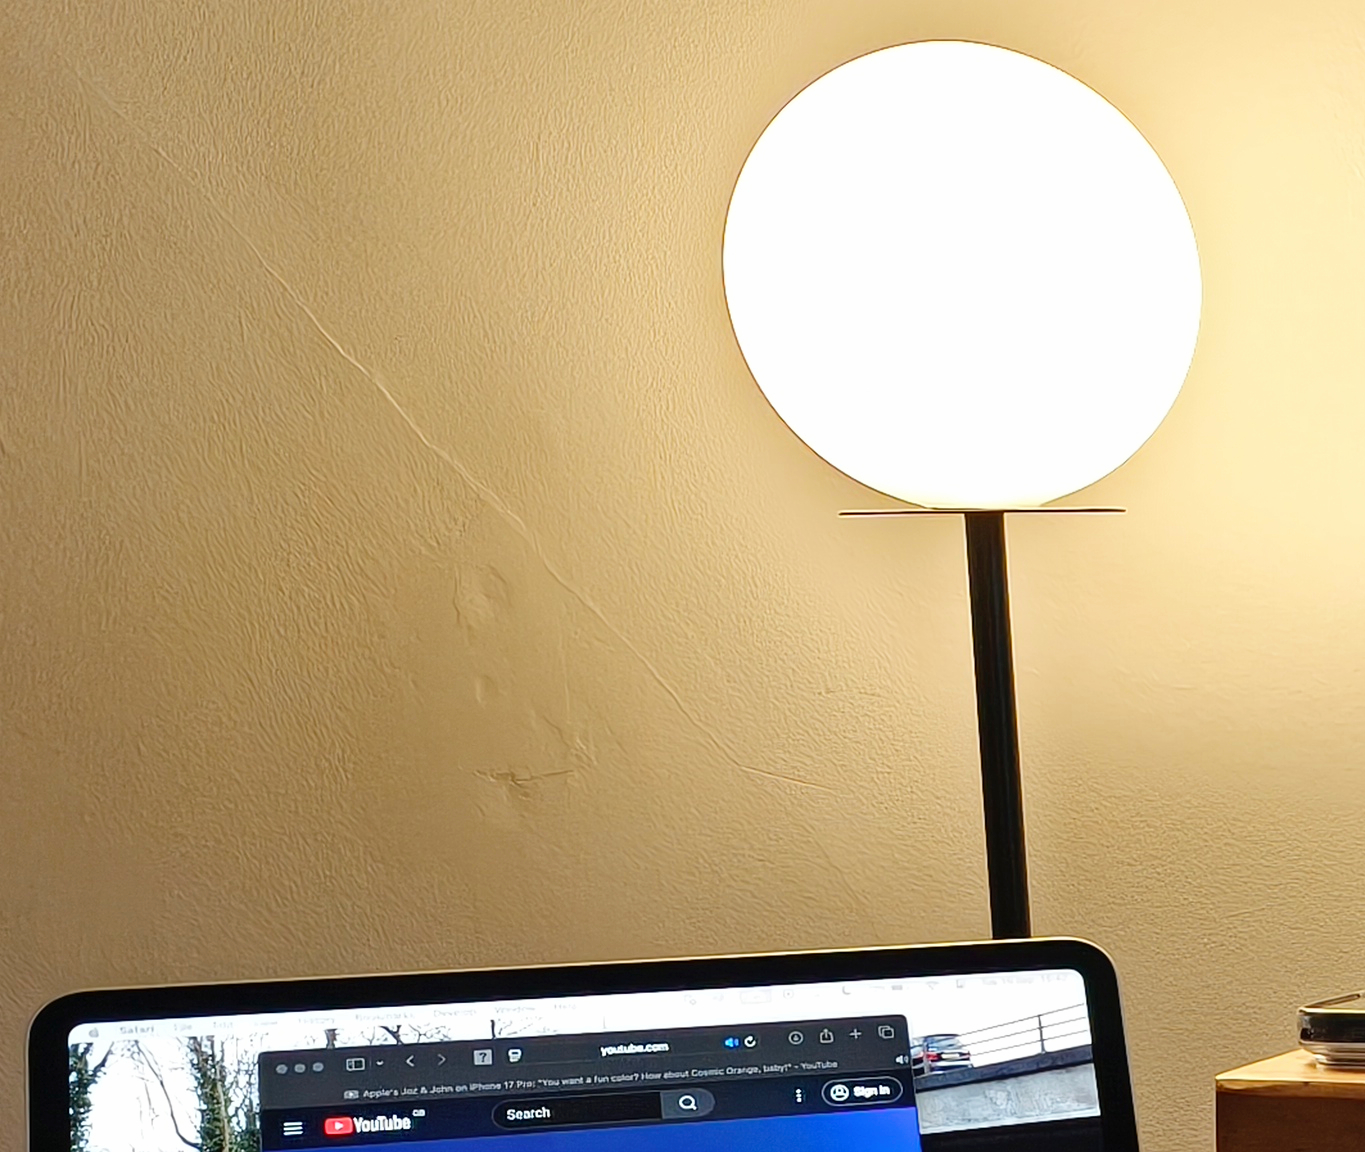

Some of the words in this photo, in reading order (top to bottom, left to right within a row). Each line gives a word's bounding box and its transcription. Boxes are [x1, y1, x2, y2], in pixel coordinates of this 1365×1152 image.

[601, 1041, 669, 1056] youtube.com
[363, 1088, 399, 1099] Apple's
[429, 1084, 454, 1095] John
[455, 1084, 468, 1093] on
[503, 1081, 515, 1090] 17
[562, 1077, 584, 1086] want
[593, 1075, 609, 1083] fun
[641, 1072, 661, 1081] How
[663, 1070, 689, 1080] about
[691, 1068, 724, 1078] Cosmic
[800, 1060, 838, 1071] YouTube
[853, 1085, 877, 1098] Sign
[879, 1084, 891, 1096] in
[506, 1107, 552, 1121] Search
[353, 1116, 411, 1133] YouTube
